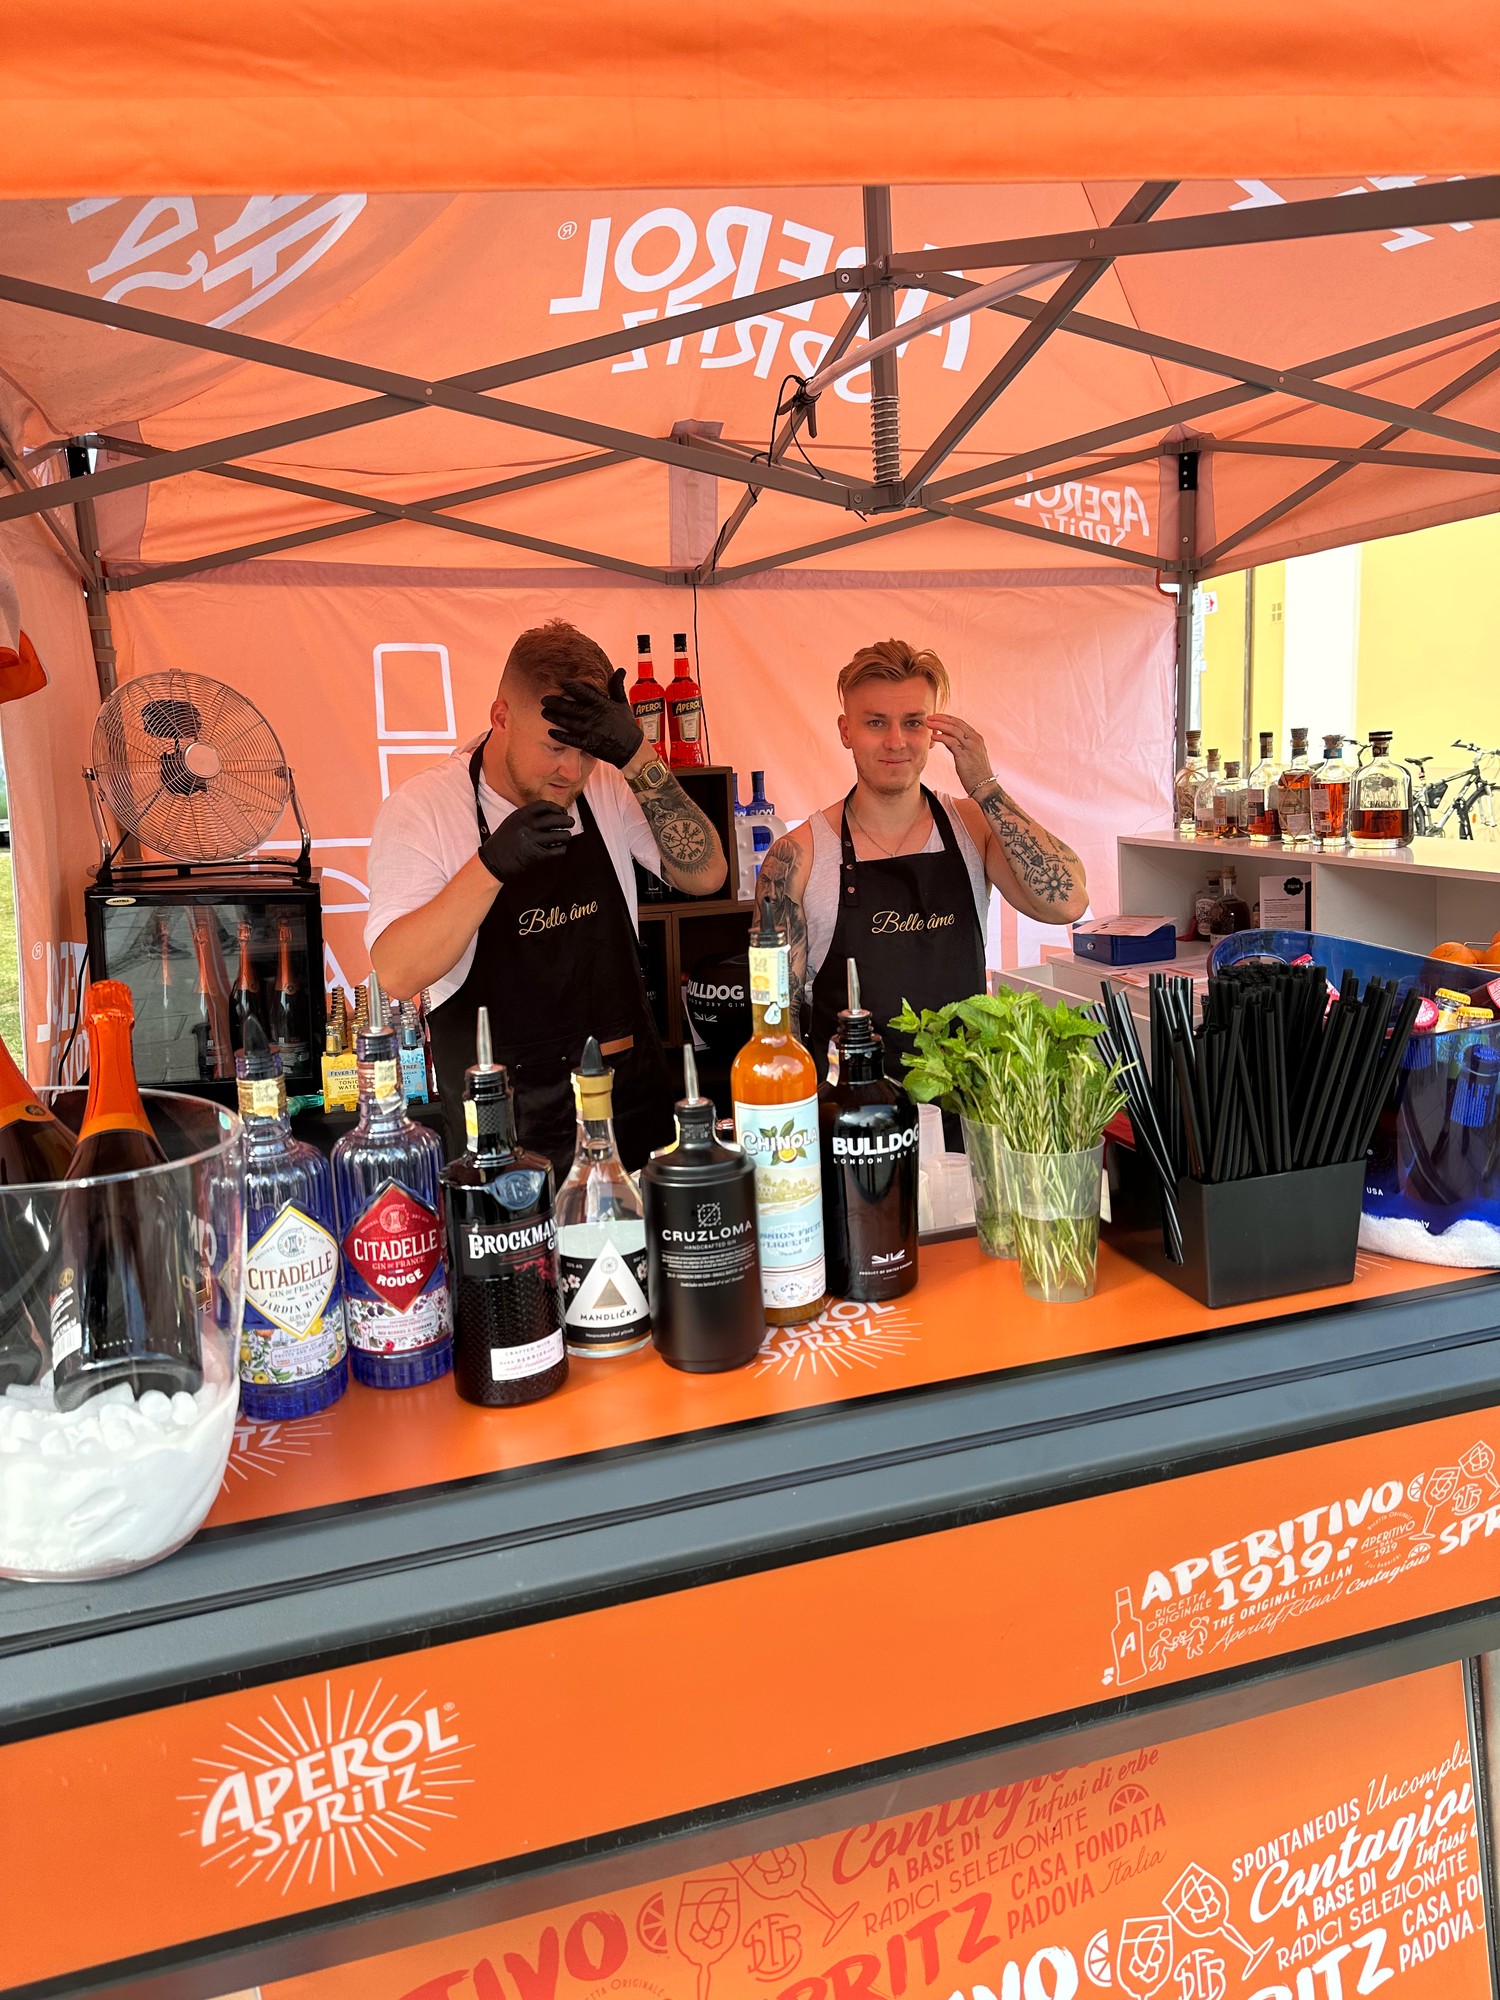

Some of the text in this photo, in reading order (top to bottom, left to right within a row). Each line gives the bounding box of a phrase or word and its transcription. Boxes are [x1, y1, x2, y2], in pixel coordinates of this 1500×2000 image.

[636, 701, 663, 716] APEROL
[519, 900, 599, 936] Belle âme
[871, 910, 956, 934] Belle âme
[741, 1126, 818, 1157] CHINOLA
[833, 1156, 883, 1165] LONDON
[1366, 1186, 1384, 1197] USA
[353, 1228, 438, 1262] CITADELLE
[661, 1219, 753, 1243] CRUZLOMA
[247, 1250, 334, 1291] CITADELLE
[372, 1262, 388, 1271] GIN
[376, 1268, 424, 1288] ROUGE
[260, 1299, 301, 1314] JARDIN
[269, 1290, 284, 1298] GIN
[580, 1307, 638, 1322] MANDLIČKA
[1140, 1480, 1404, 1611] APERITIVO
[1360, 1520, 1416, 1551] APERITIVO
[1373, 1541, 1398, 1560] 1919
[1154, 1589, 1208, 1620] RICETTA
[1209, 1552, 1432, 1655] Aperitif Ritual Contagious
[1212, 1563, 1353, 1631] THE ORIGINAL ITALIAN
[1145, 1597, 1214, 1632] ORIGINALE
[1120, 1631, 1137, 1659] A
[201, 1706, 460, 1848] APEROL
[887, 1748, 1160, 1894] A BASE DI Infusi di erbe
[1010, 1802, 1168, 1901] CASA FONDATA
[1231, 1797, 1361, 1883] SPONTANEOUS
[862, 1806, 1089, 1938] RADICI SELEZIONATE
[1296, 1905, 1310, 1931] A
[1312, 1878, 1356, 1922] BASE
[1359, 1867, 1378, 1898] DI
[1413, 1823, 1469, 1870] Infusi
[1007, 1845, 1169, 1940] PADOVA Italia
[1275, 1848, 1470, 1971] RADICI SELEZIONATE
[1401, 1890, 1453, 1937] CASA
[1398, 1908, 1475, 1974] PADOVA
[610, 1978, 665, 1998] ORIGINALE
